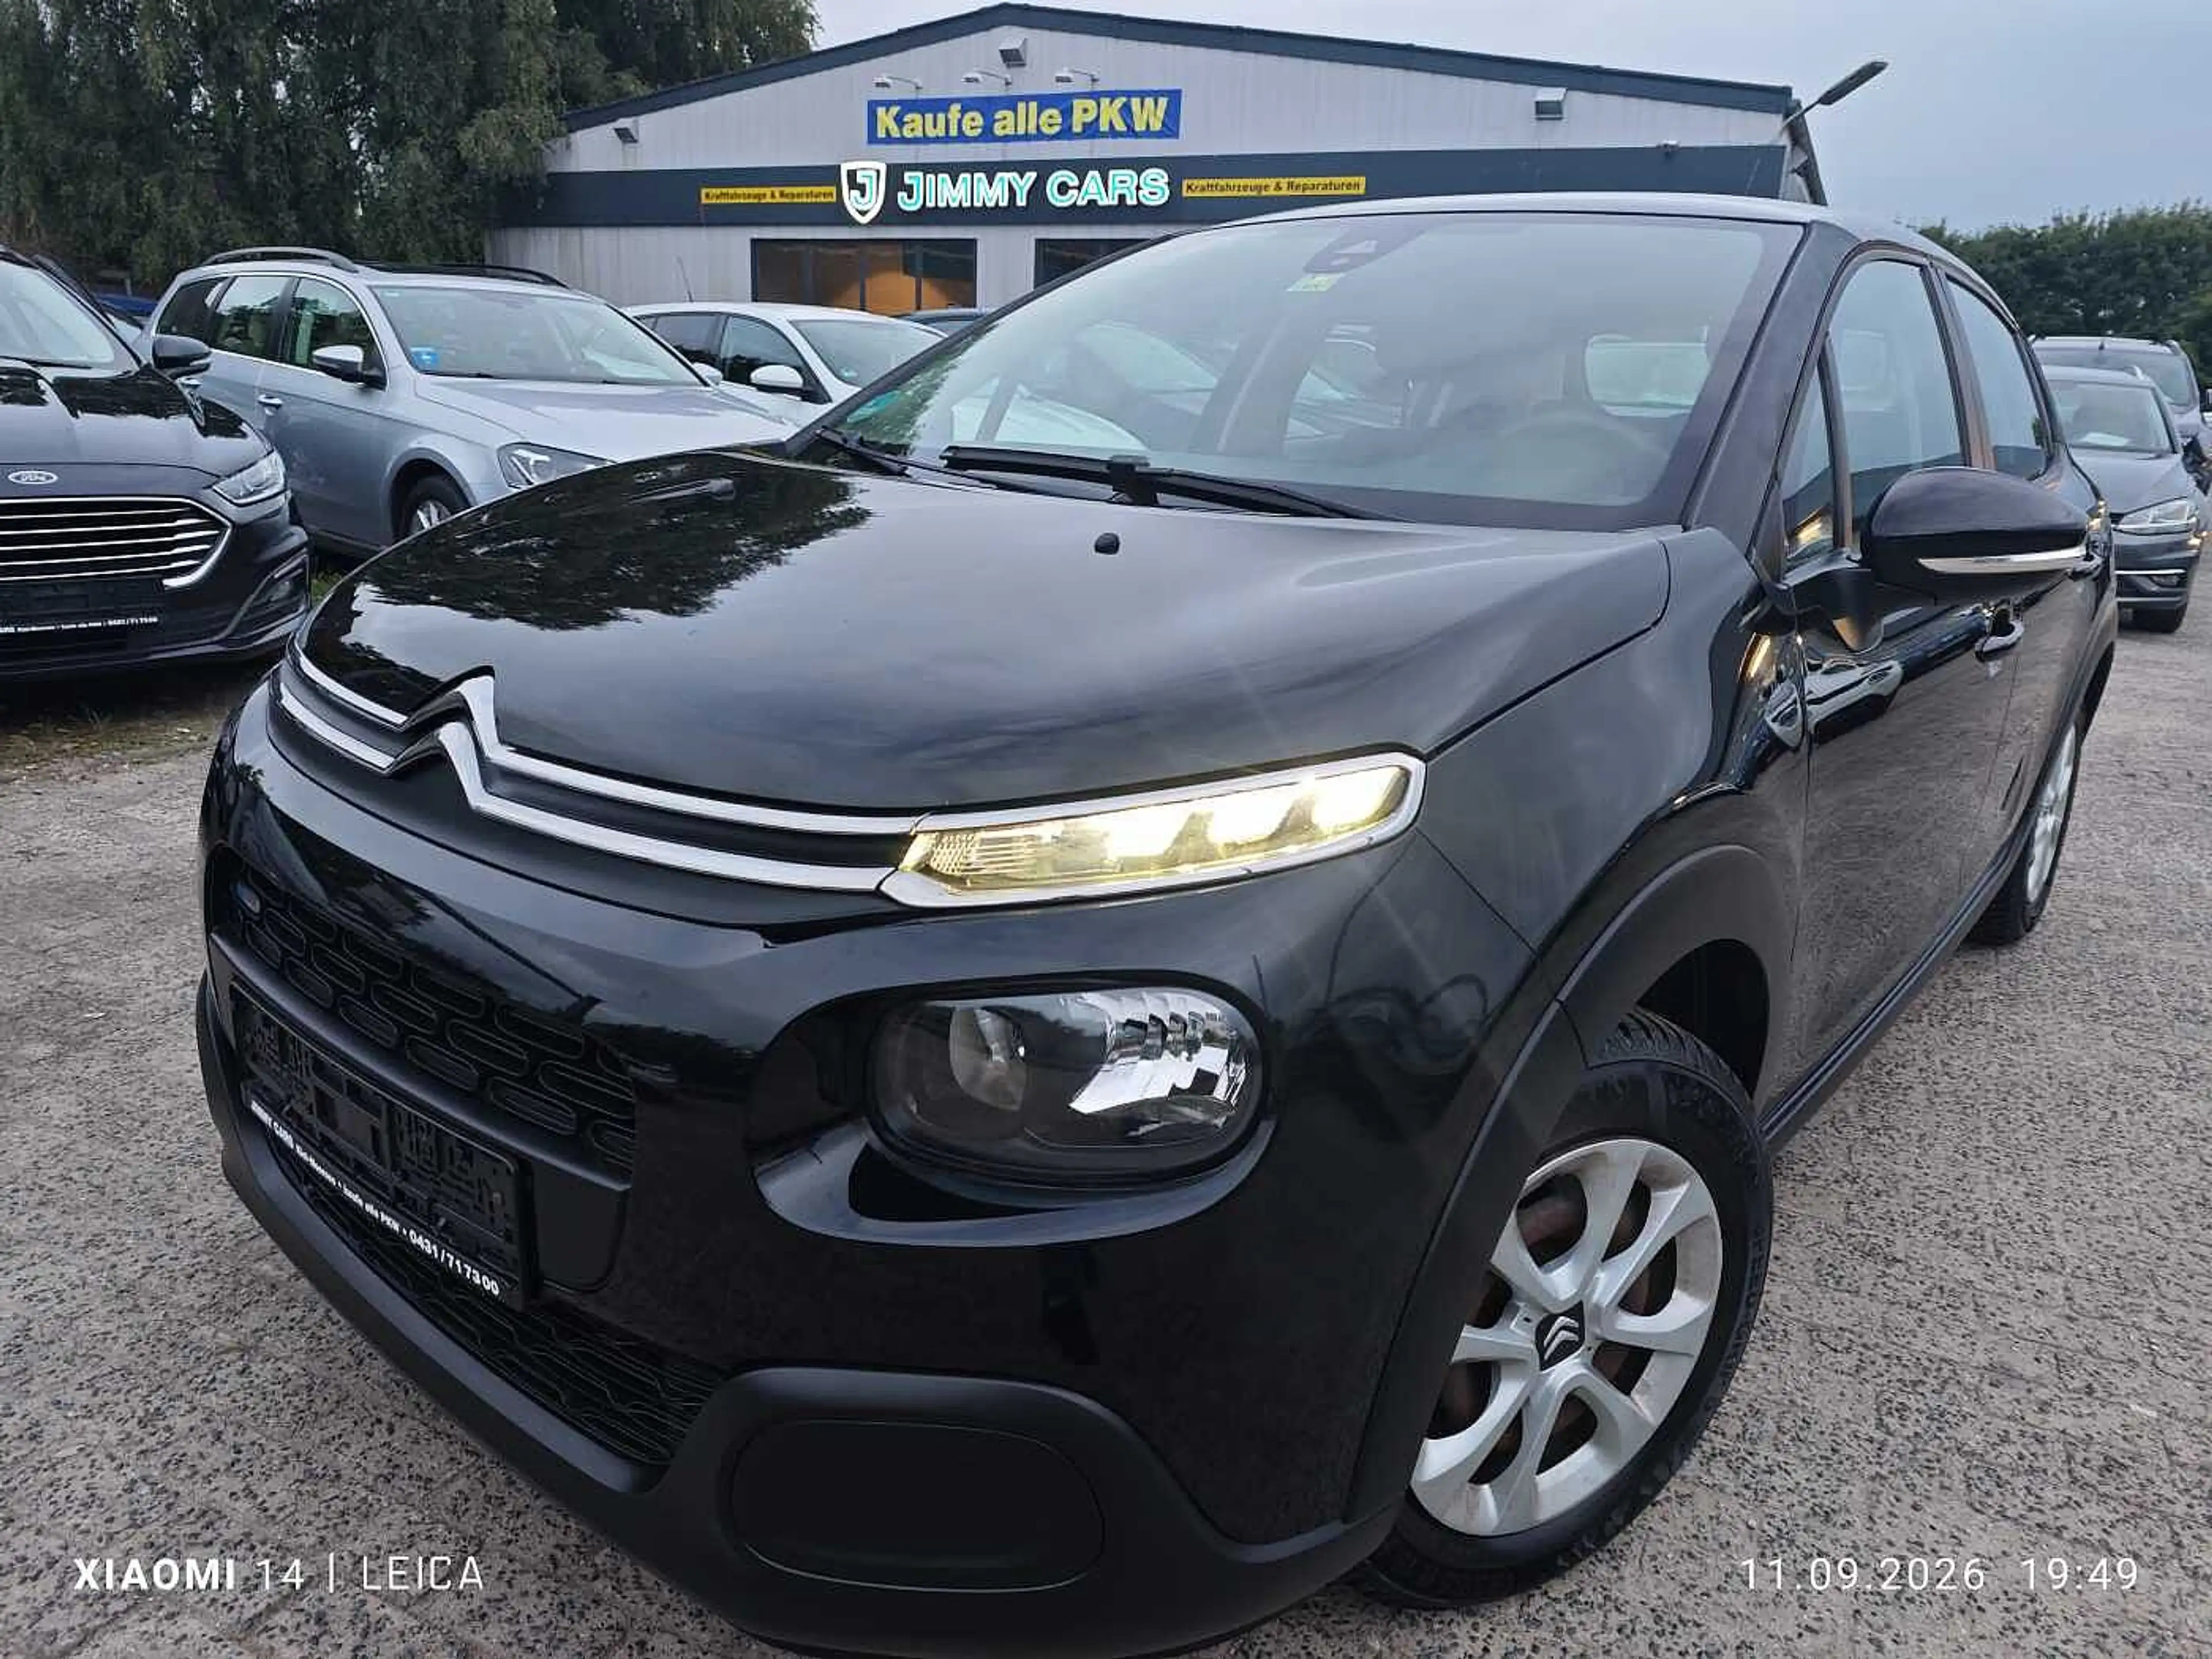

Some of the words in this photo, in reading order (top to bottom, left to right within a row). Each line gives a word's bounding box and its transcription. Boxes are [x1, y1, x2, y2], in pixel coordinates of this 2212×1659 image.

[876, 103, 984, 138] Kaufe
[993, 100, 1063, 136] alle
[1071, 96, 1169, 134] PKW
[897, 172, 1037, 211] JIMMY
[1046, 168, 1170, 208] CARS
[1185, 182, 1270, 194] Kraftfahrzeuge
[1273, 183, 1282, 192] &
[1286, 180, 1361, 193] Reparaturen
